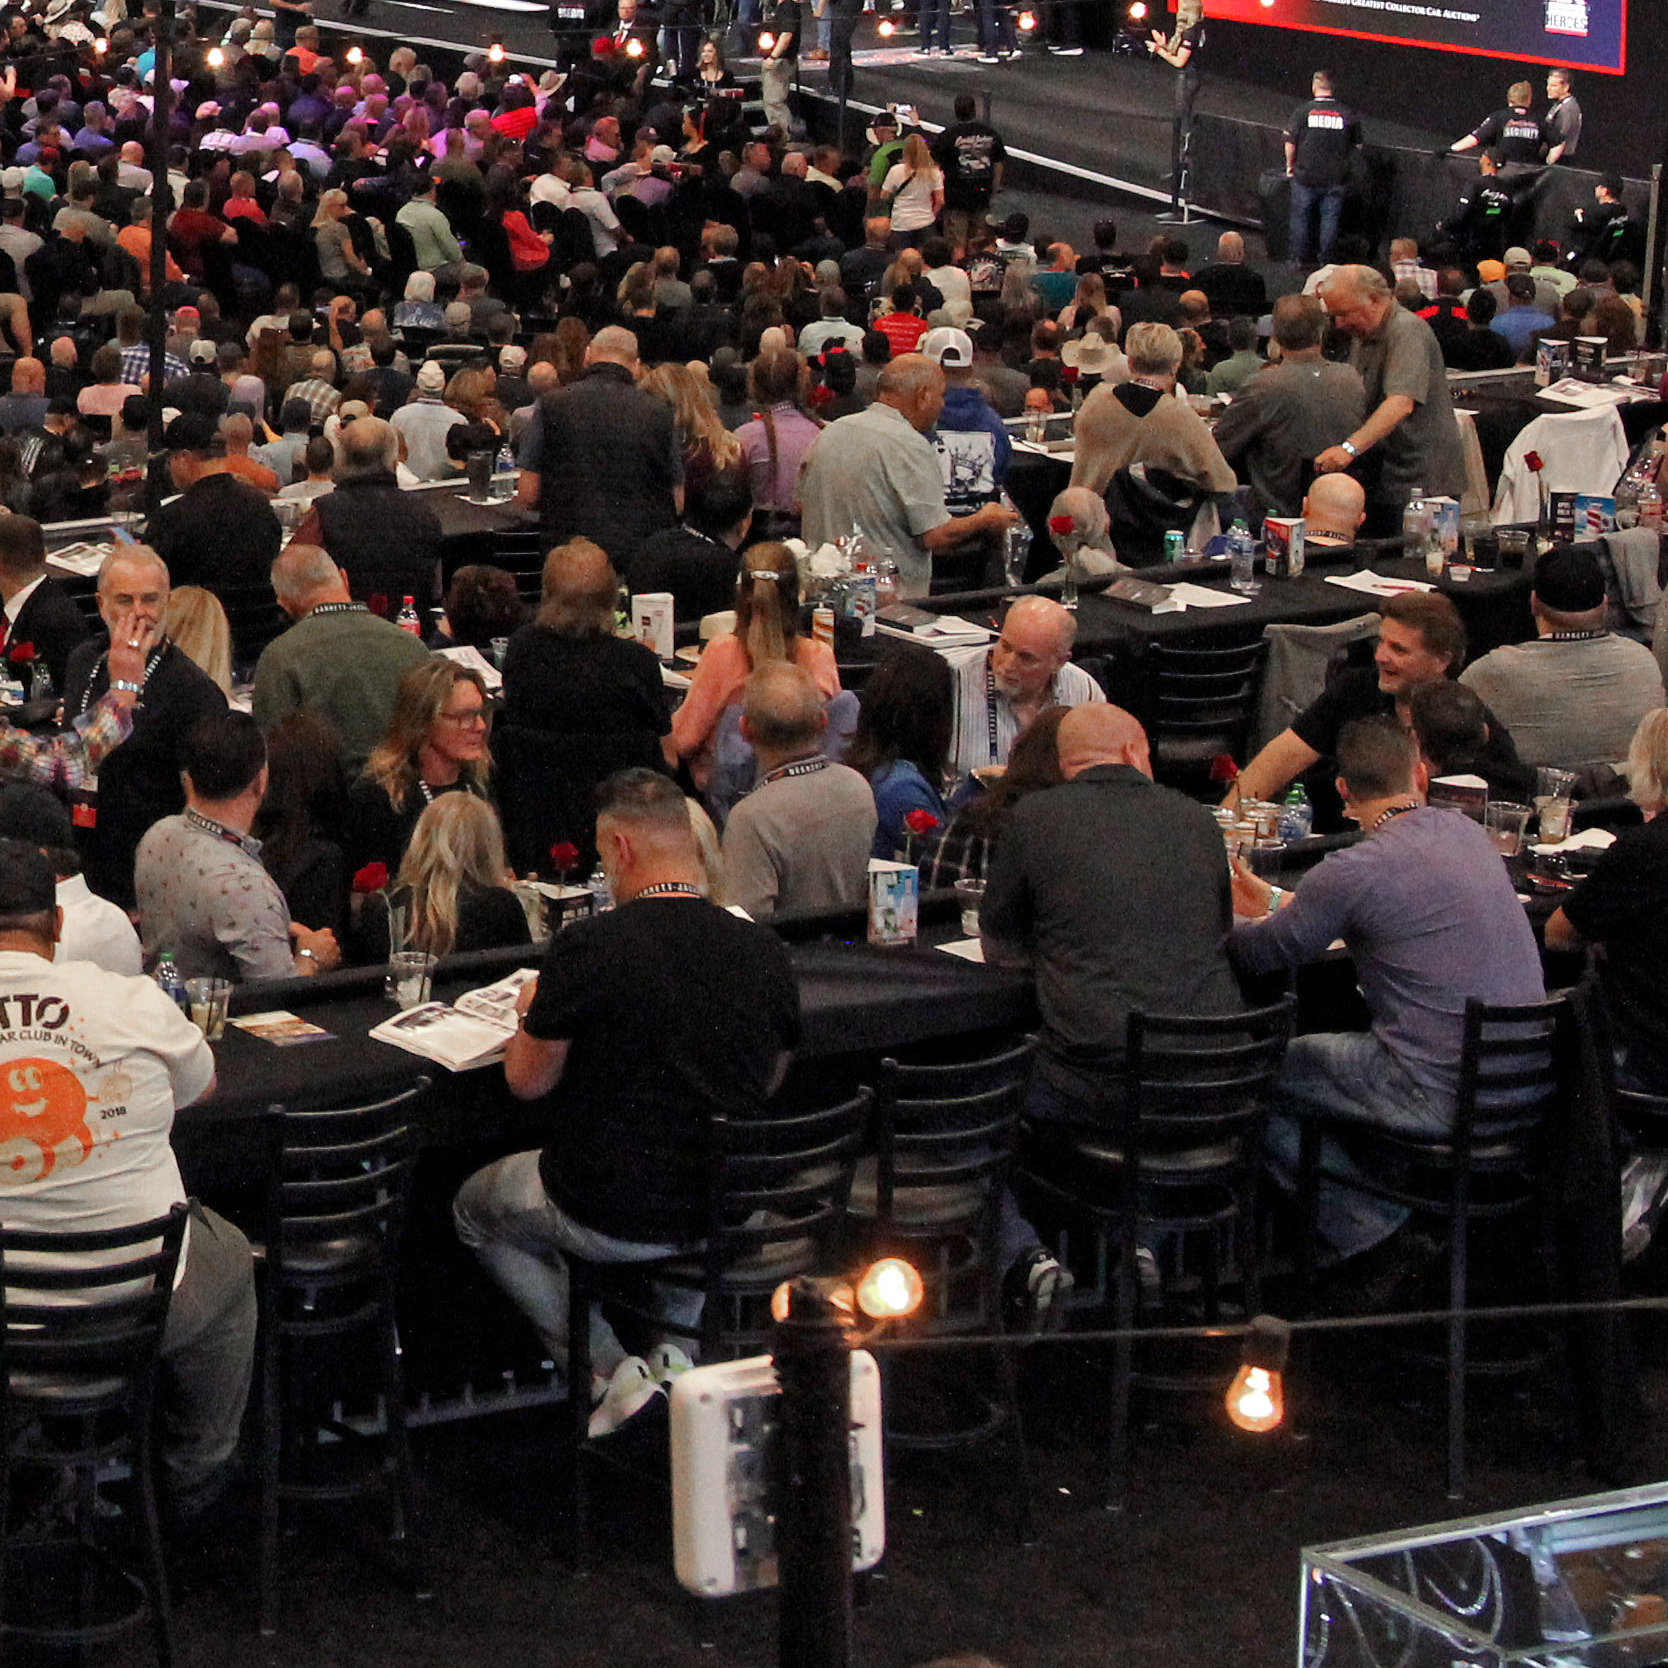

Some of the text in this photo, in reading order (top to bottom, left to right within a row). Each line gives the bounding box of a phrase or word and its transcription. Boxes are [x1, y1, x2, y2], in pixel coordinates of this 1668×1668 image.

[1308, 114, 1344, 130] MEDIA
[19, 1030, 52, 1042] CLUB
[54, 1034, 67, 1046] IN
[70, 1039, 101, 1069] TOWN
[99, 1106, 128, 1120] 2018
